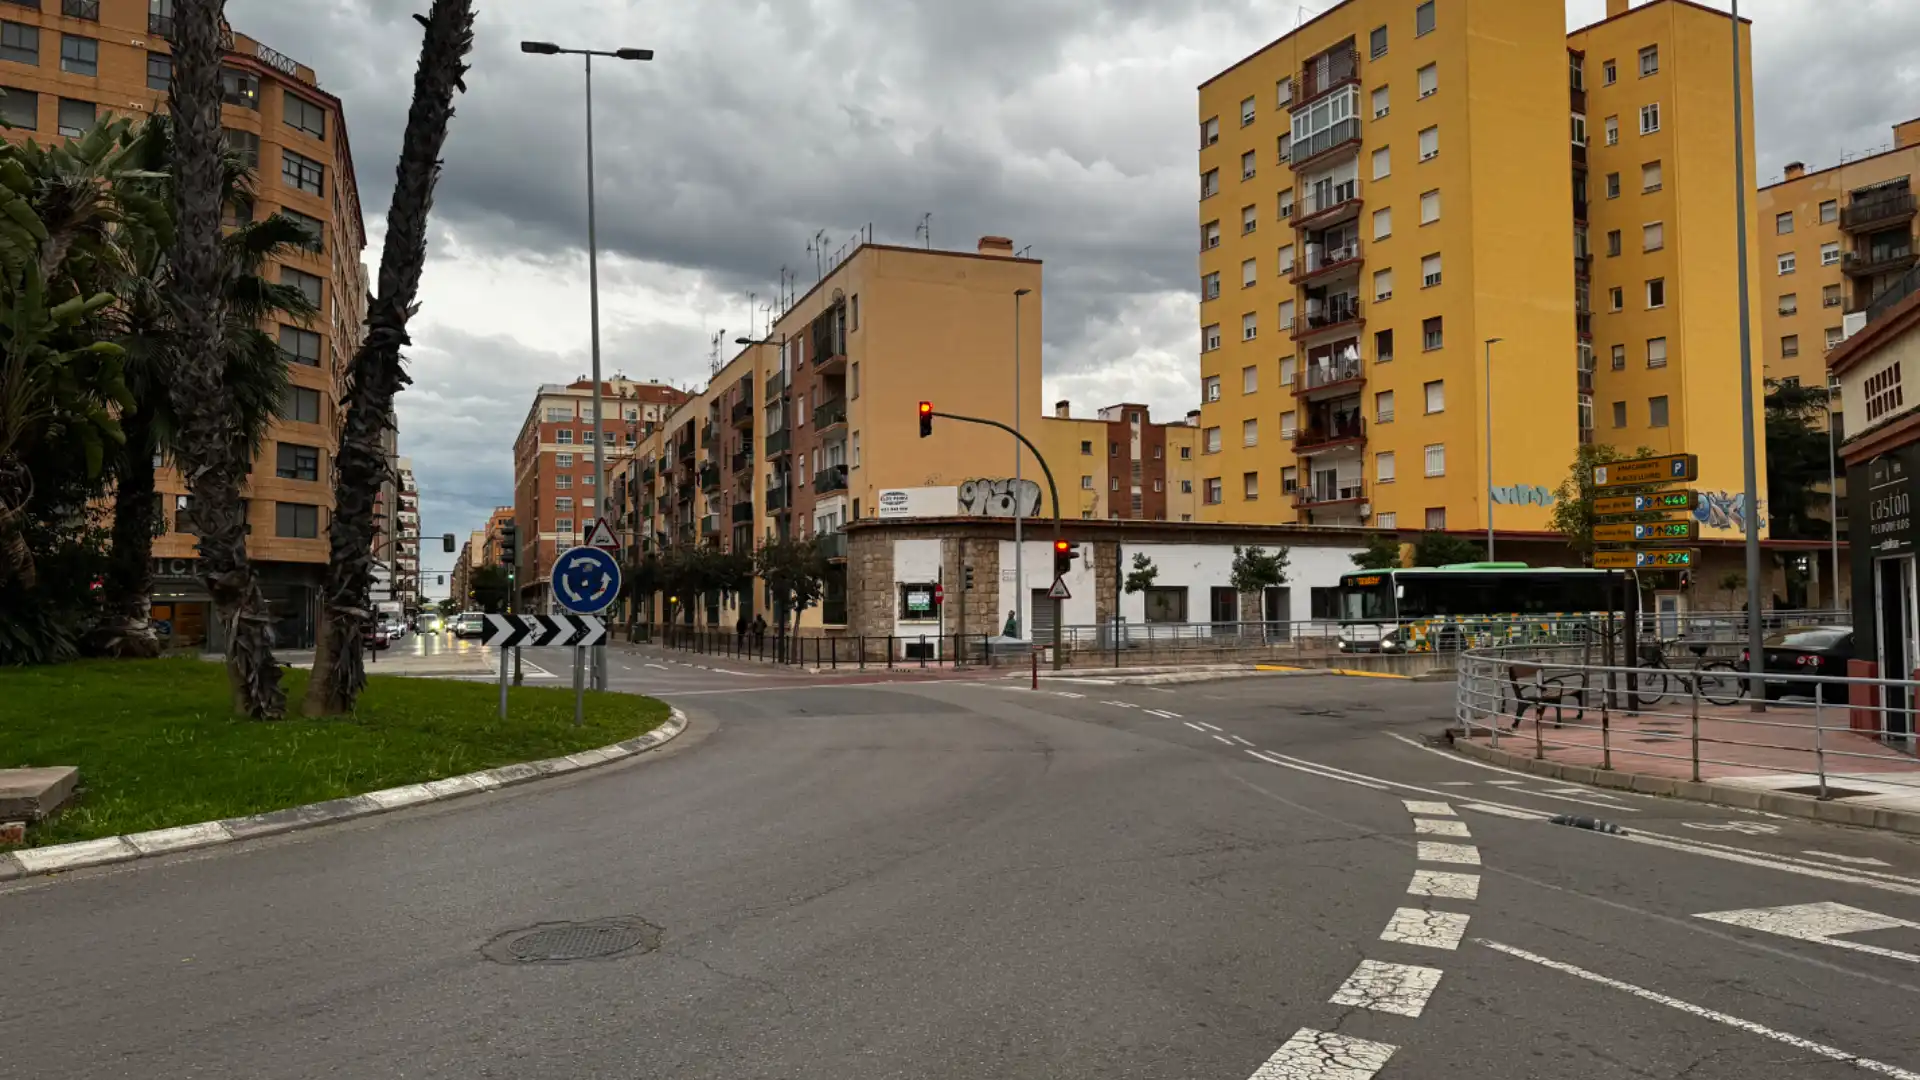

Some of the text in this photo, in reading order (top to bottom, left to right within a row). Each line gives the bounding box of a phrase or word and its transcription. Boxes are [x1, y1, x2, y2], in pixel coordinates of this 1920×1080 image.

[1674, 462, 1682, 474] P
[1635, 497, 1643, 510] P
[1664, 495, 1687, 505] 440
[1635, 525, 1644, 537] P
[1665, 525, 1688, 536] 295
[1637, 553, 1645, 565] P
[1666, 553, 1689, 564] 274
